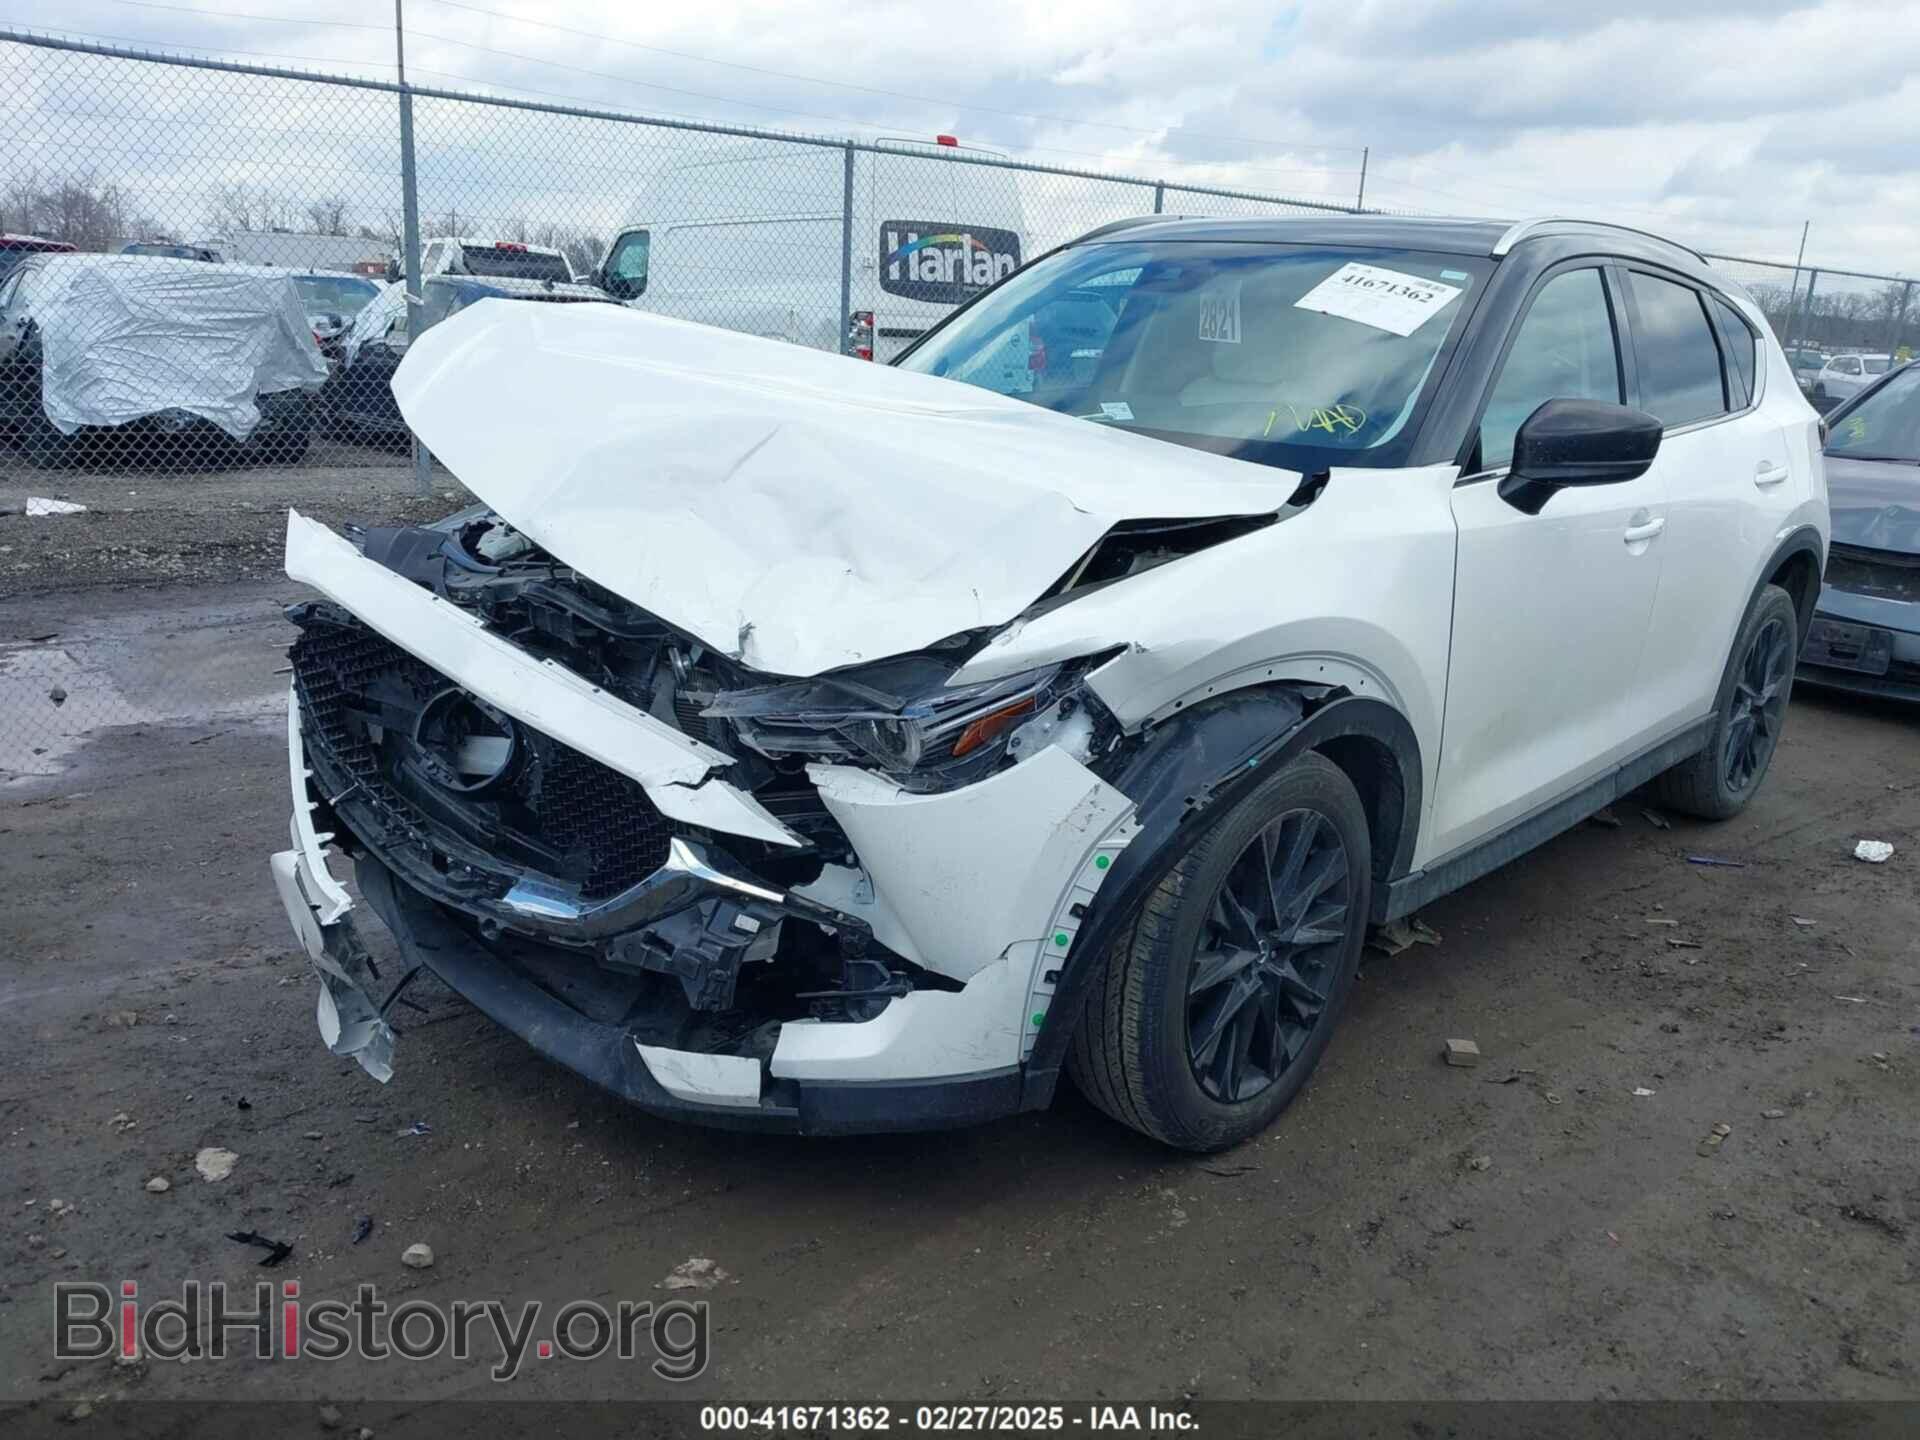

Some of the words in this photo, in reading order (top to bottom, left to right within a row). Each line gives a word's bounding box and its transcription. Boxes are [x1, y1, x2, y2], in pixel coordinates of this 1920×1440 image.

[887, 231, 1015, 286] Harlan
[1342, 273, 1435, 304] 41671362
[1200, 299, 1236, 340] 2821
